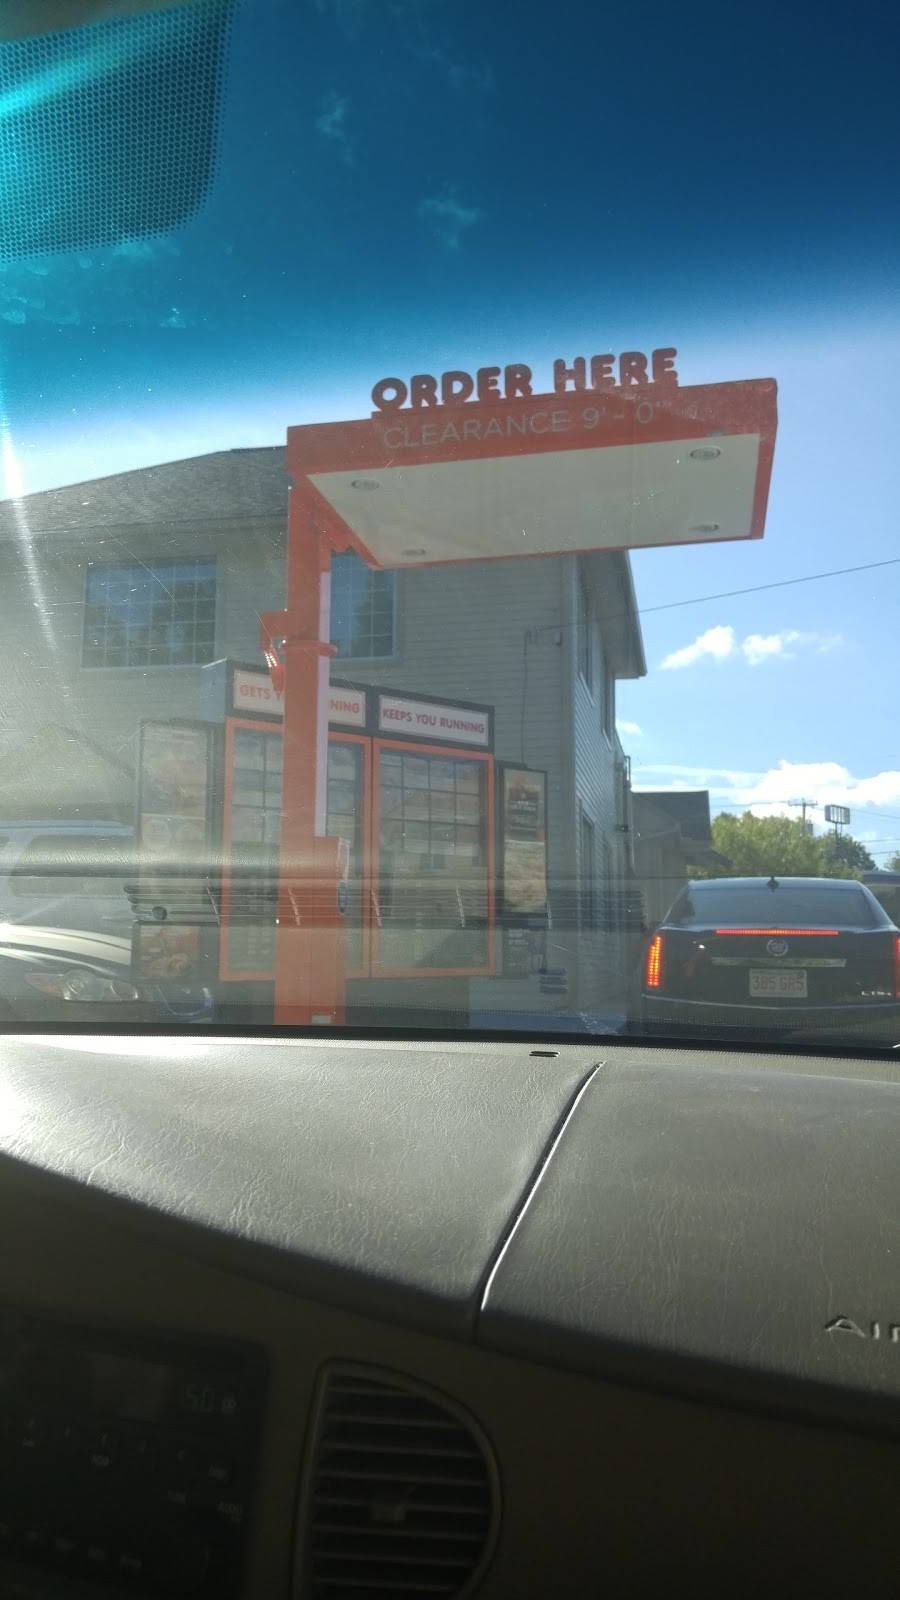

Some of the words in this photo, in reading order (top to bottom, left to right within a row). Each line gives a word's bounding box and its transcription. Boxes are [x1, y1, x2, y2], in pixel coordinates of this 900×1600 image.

[371, 363, 533, 412] ORDER
[554, 347, 678, 393] HERE
[383, 410, 570, 449] CLEARANCE
[239, 684, 272, 700] GETS
[382, 707, 414, 723] KEEPS
[415, 712, 437, 726] YOU
[439, 717, 485, 734] RUNNING
